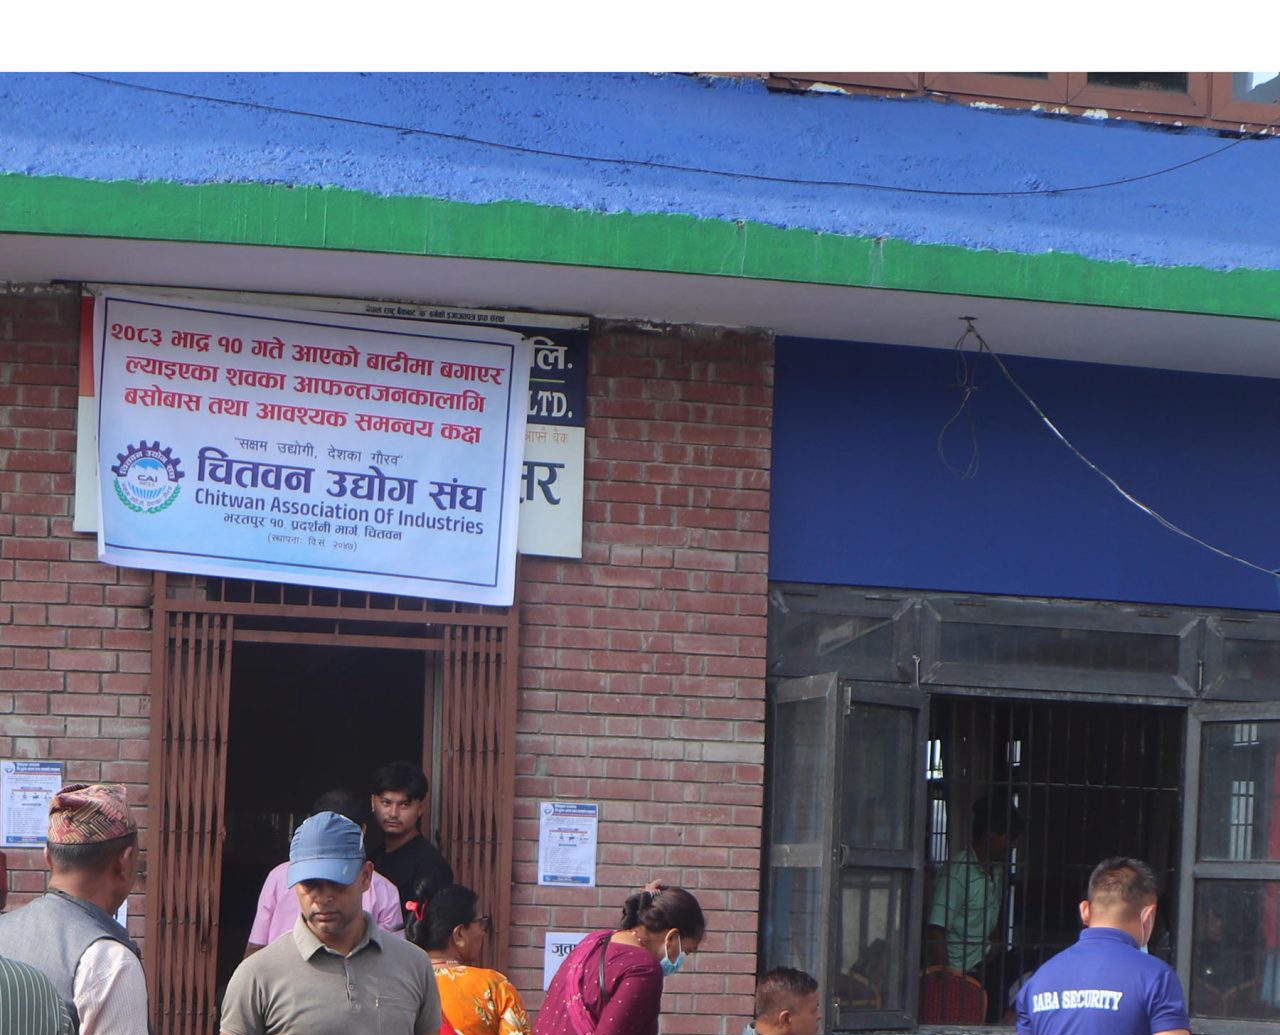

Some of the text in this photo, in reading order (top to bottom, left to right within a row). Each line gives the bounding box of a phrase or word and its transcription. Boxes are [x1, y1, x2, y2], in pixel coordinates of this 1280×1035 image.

[111, 323, 505, 385] २०८३ भाद्र १० गते आएको बाढीमा बगाएर
[125, 356, 487, 413] ल्याइएका शवका आफन्तजनकालागि
[528, 390, 573, 419] LTD.
[124, 384, 483, 445] बसोबास तथा आवश्यक समन्वय कक्ष
[327, 446, 362, 462] देशका
[197, 446, 316, 494] चितवन
[326, 465, 418, 505] उद्योग
[429, 477, 487, 513] संघ
[195, 487, 266, 512] Chitwan
[270, 496, 370, 523] Association
[374, 507, 394, 526] Of
[398, 510, 484, 535] Industries
[224, 513, 266, 528] भरतपुर
[364, 524, 403, 541] चितवन
[1061, 989, 1123, 1011] SECURITY
